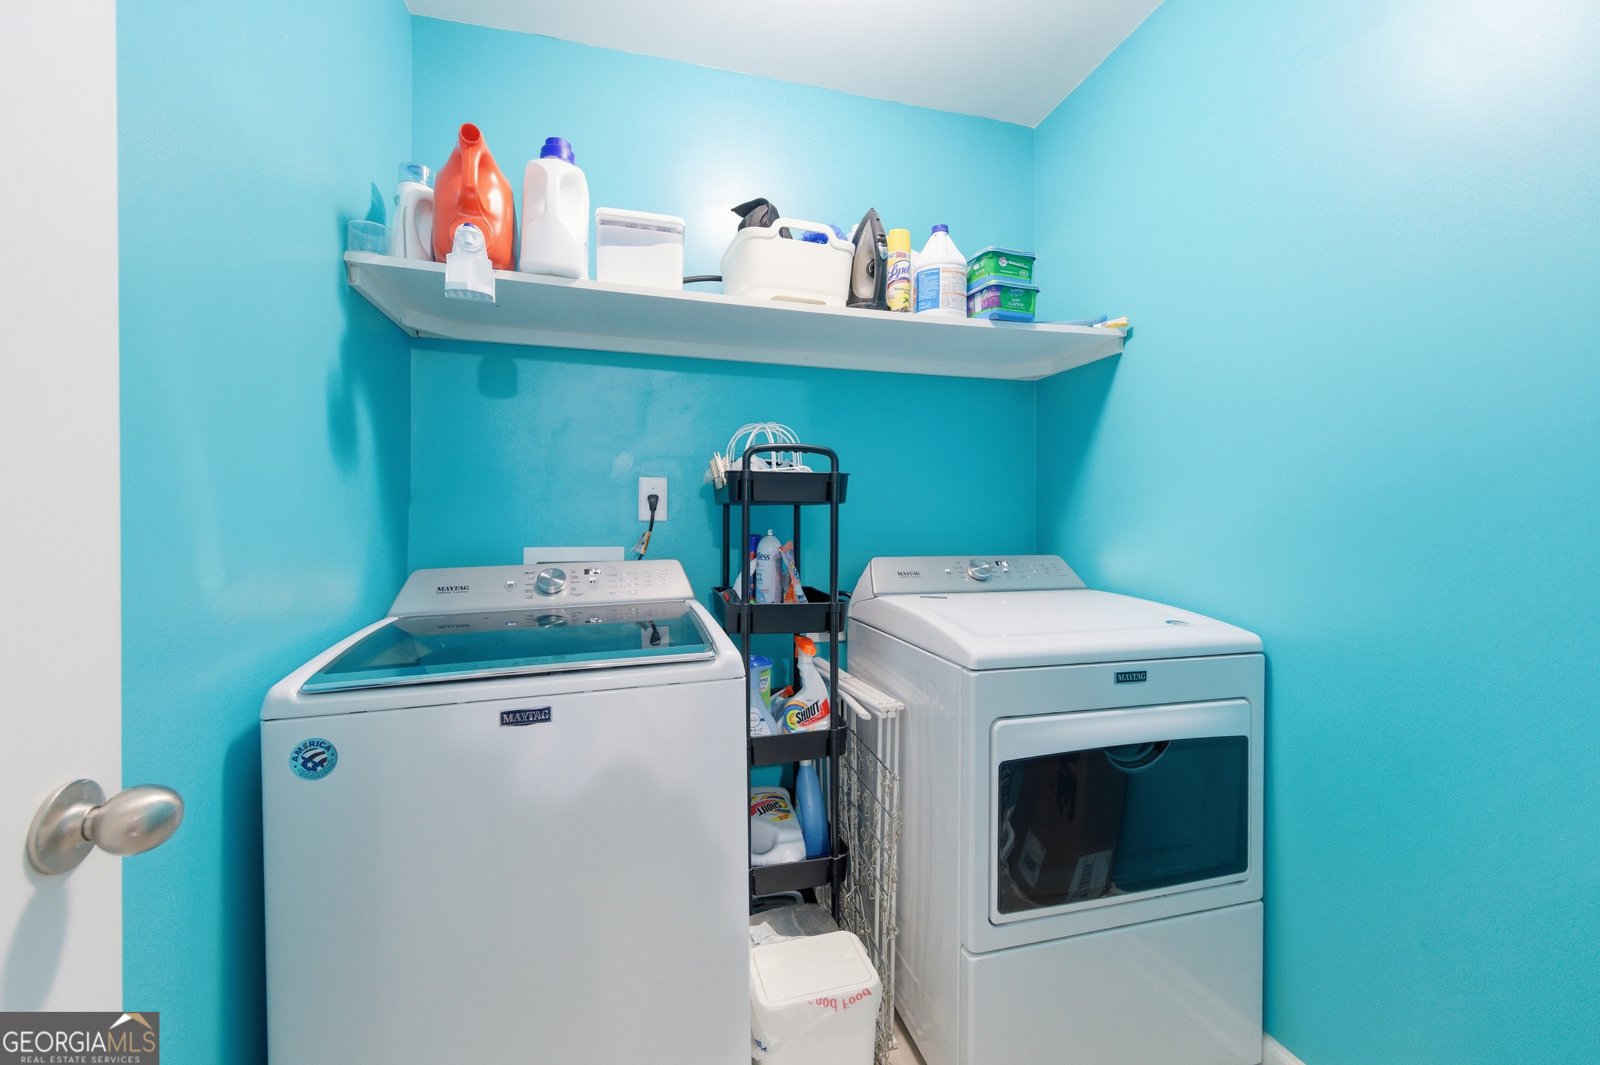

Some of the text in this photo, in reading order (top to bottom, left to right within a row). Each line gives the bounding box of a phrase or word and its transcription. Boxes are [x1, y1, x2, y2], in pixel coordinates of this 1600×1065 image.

[888, 264, 910, 280] Lysol
[1117, 672, 1146, 681] MAYTAG
[502, 709, 550, 724] MAYTAG
[795, 700, 820, 724] SHOUT
[291, 740, 332, 762] AMERICA
[756, 801, 782, 817] SHOUT
